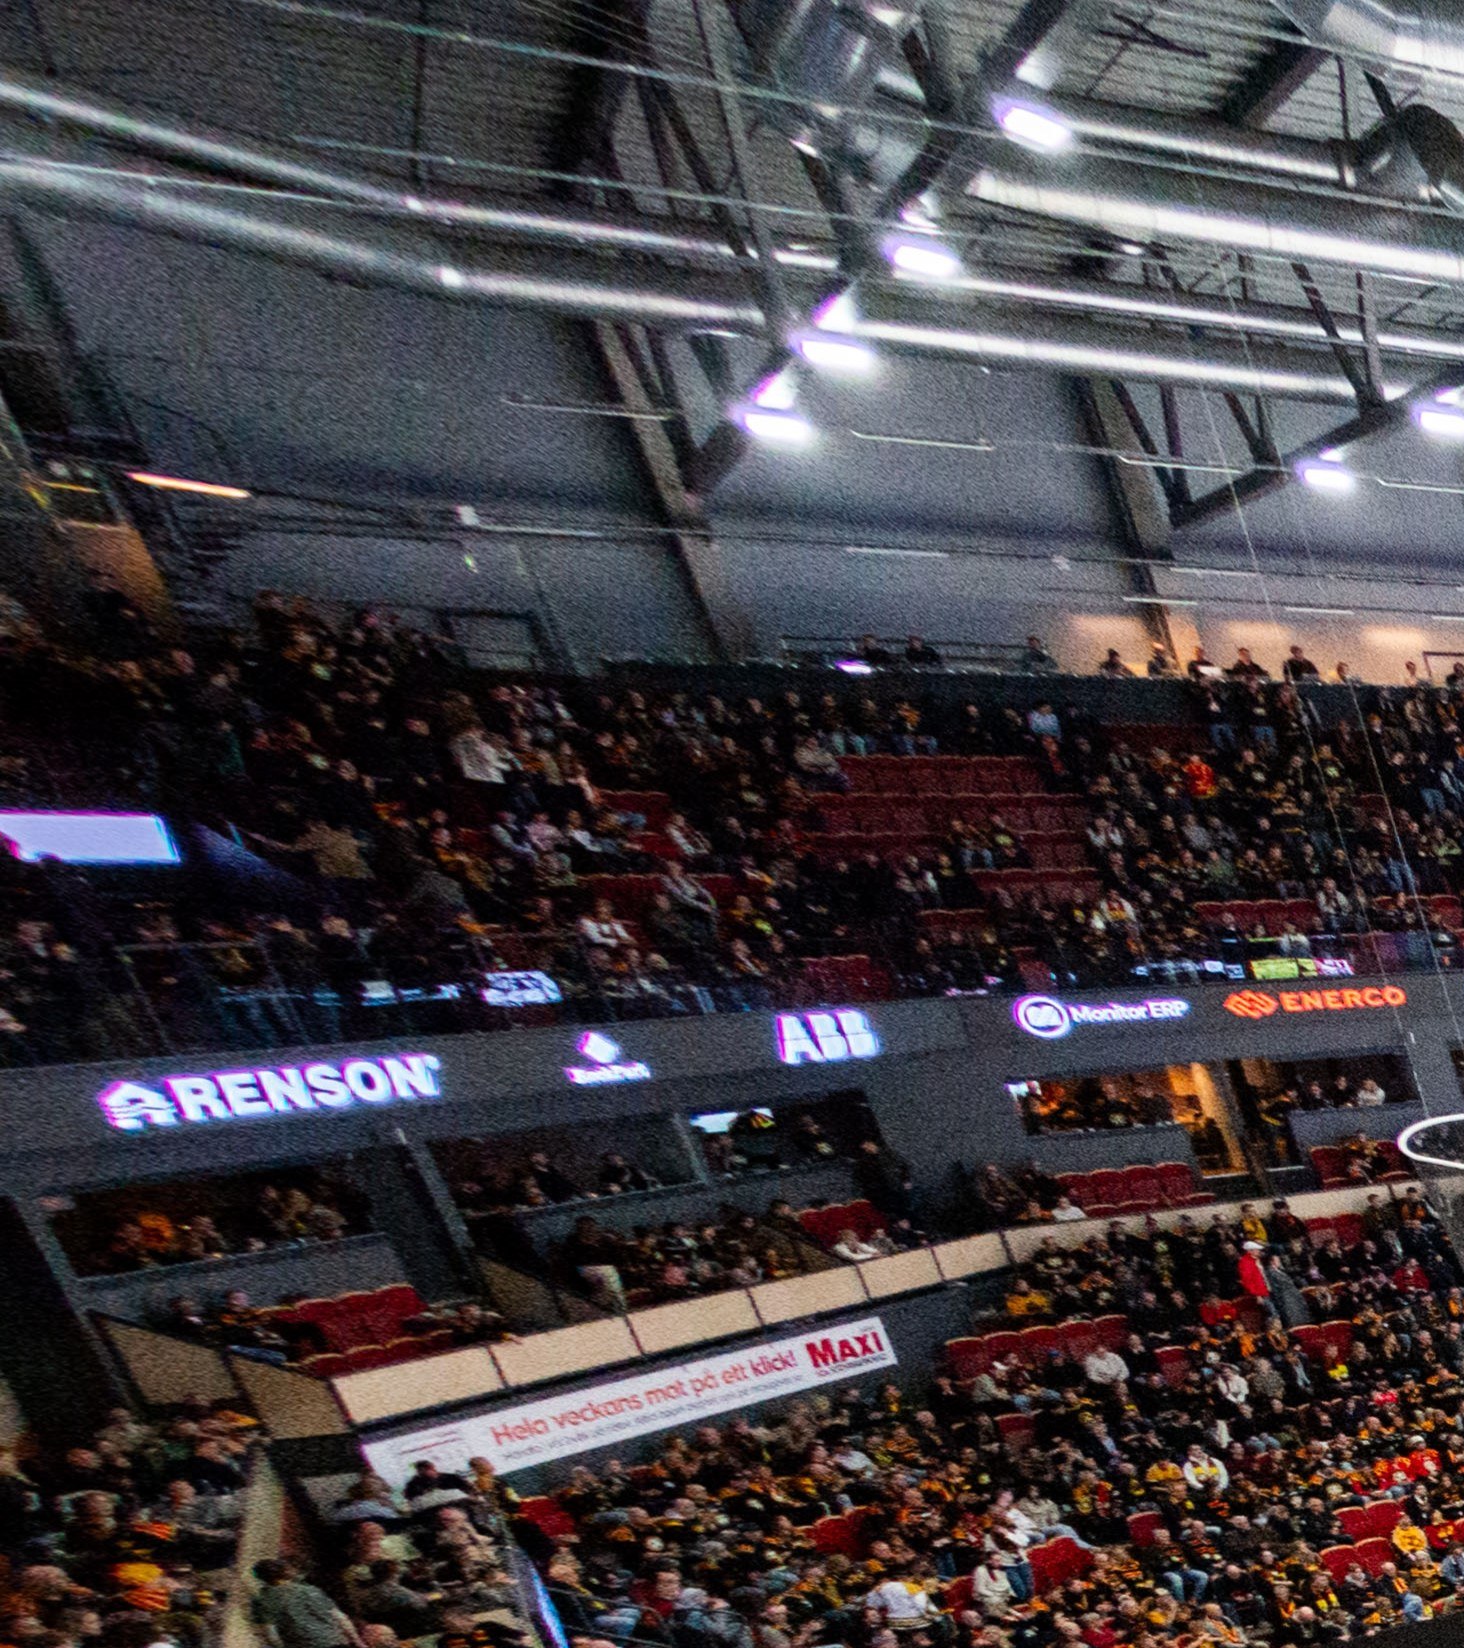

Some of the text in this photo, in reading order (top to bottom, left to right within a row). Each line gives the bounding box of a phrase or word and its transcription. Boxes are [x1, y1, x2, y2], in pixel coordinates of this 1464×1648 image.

[1071, 1000, 1190, 1025] Monitor ERP
[1280, 986, 1407, 1013] ENERCO
[776, 1010, 880, 1064] ABB
[165, 1055, 440, 1122] RENSON
[490, 1418, 548, 1447] Hela
[553, 1395, 641, 1430] veckans
[693, 1371, 717, 1398] på
[721, 1363, 748, 1386] ett
[751, 1350, 796, 1378] klick!
[806, 1331, 885, 1370] MAXI
